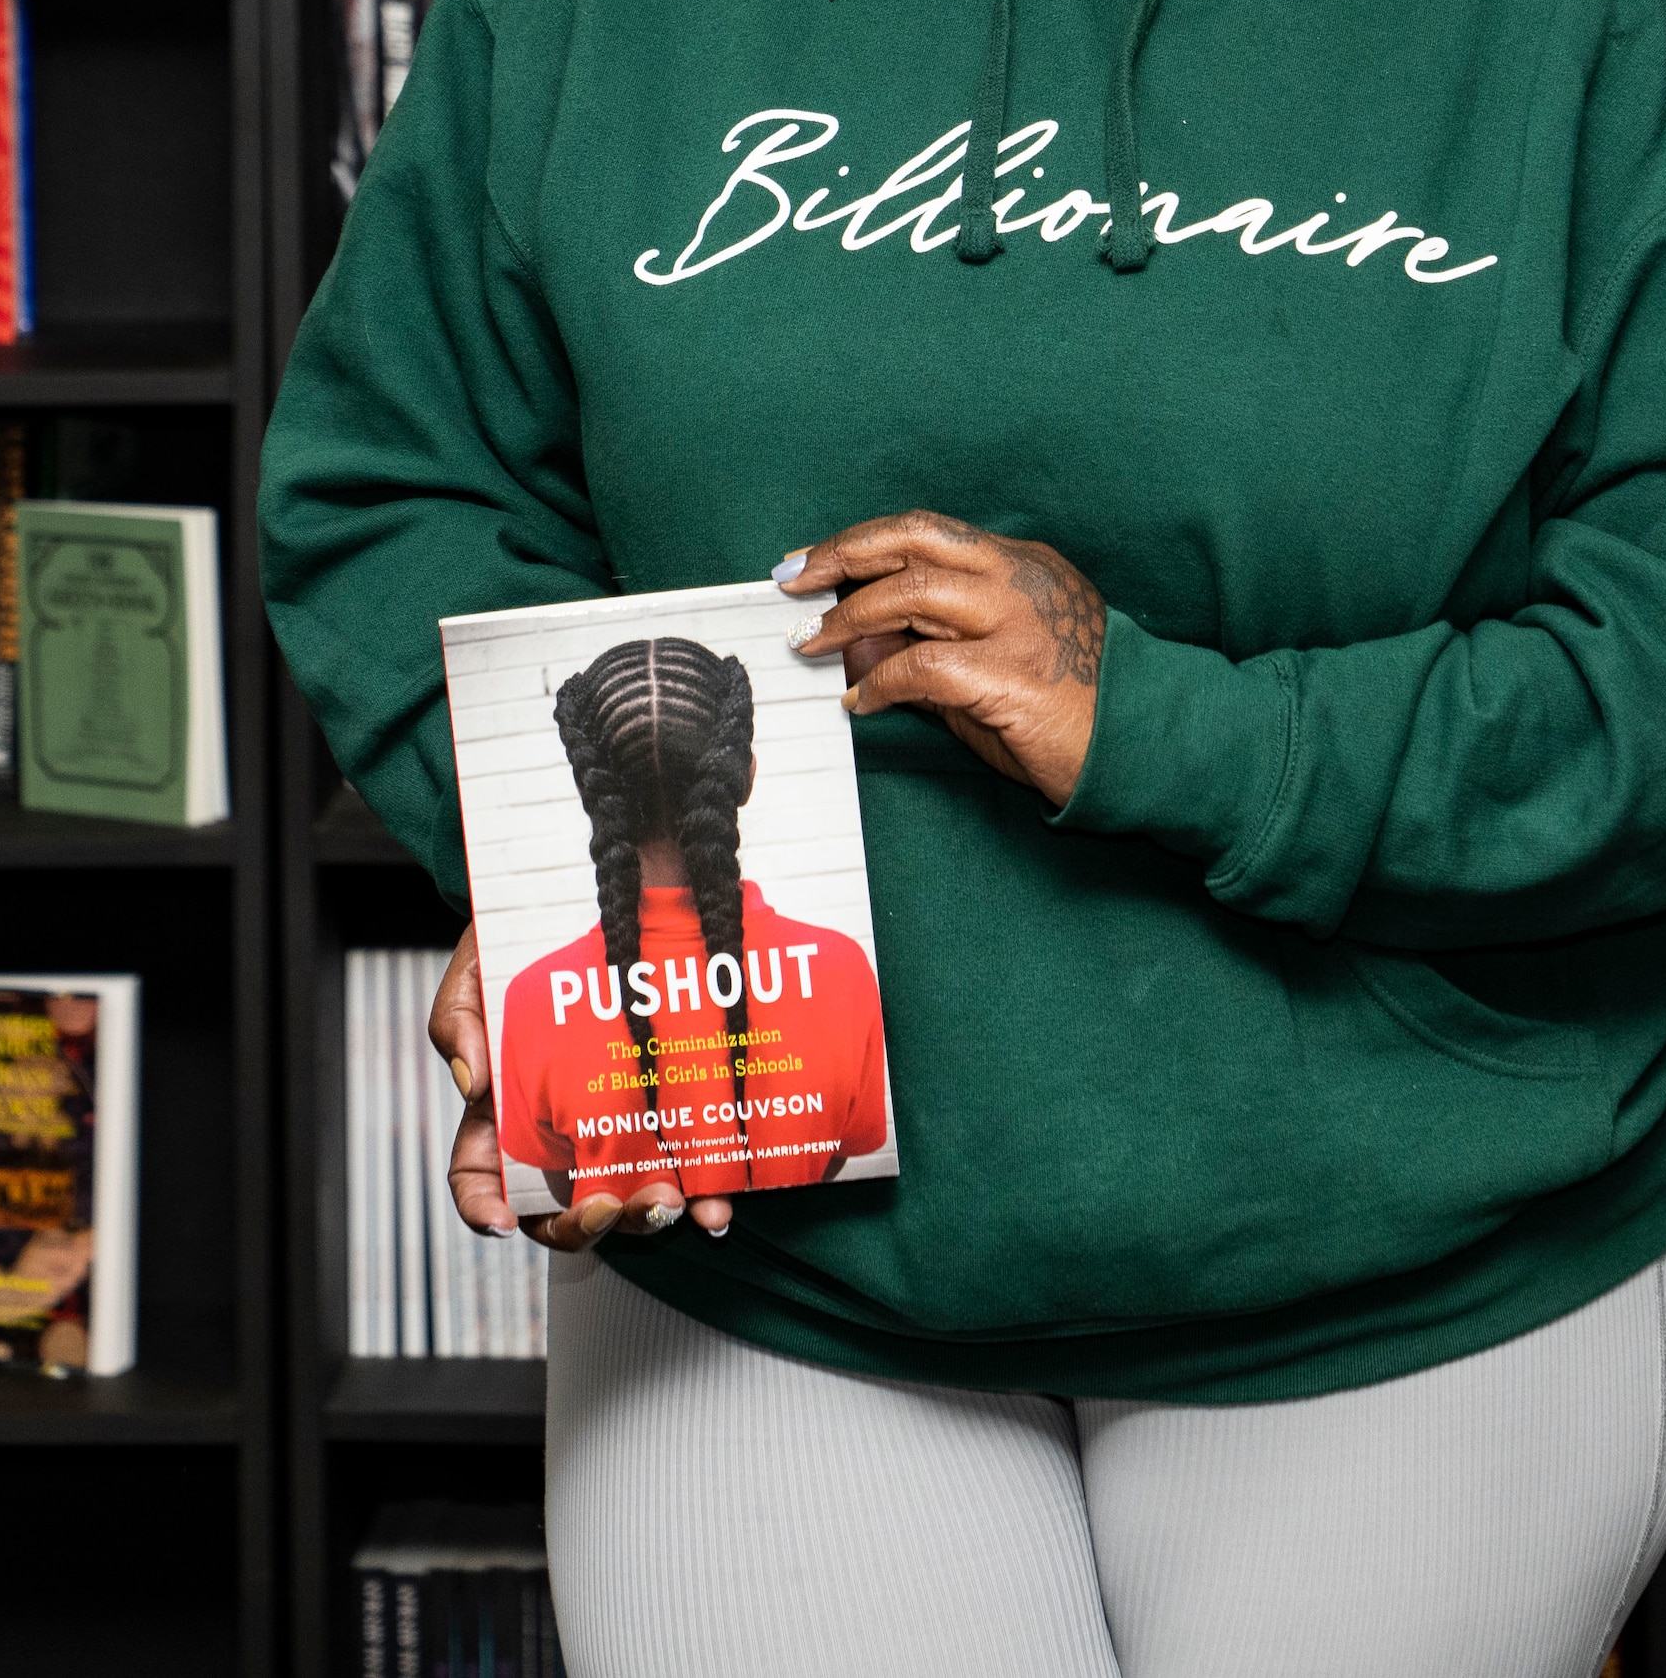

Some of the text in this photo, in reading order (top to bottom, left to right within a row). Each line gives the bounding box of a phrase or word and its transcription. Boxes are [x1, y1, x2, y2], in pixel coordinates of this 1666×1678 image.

[633, 108, 1498, 286] Billionaire
[550, 943, 819, 1025] PUSHOUT
[607, 1027, 782, 1060] The Criminalization
[587, 1053, 803, 1093] of Black Girls in Schools
[576, 1092, 824, 1139] MONIQUE COUVSON
[568, 1138, 842, 1181] MANKAPRR CONTEH and MELISSA HARRIS-PERRY
[656, 1132, 749, 1153] With a foreword by
